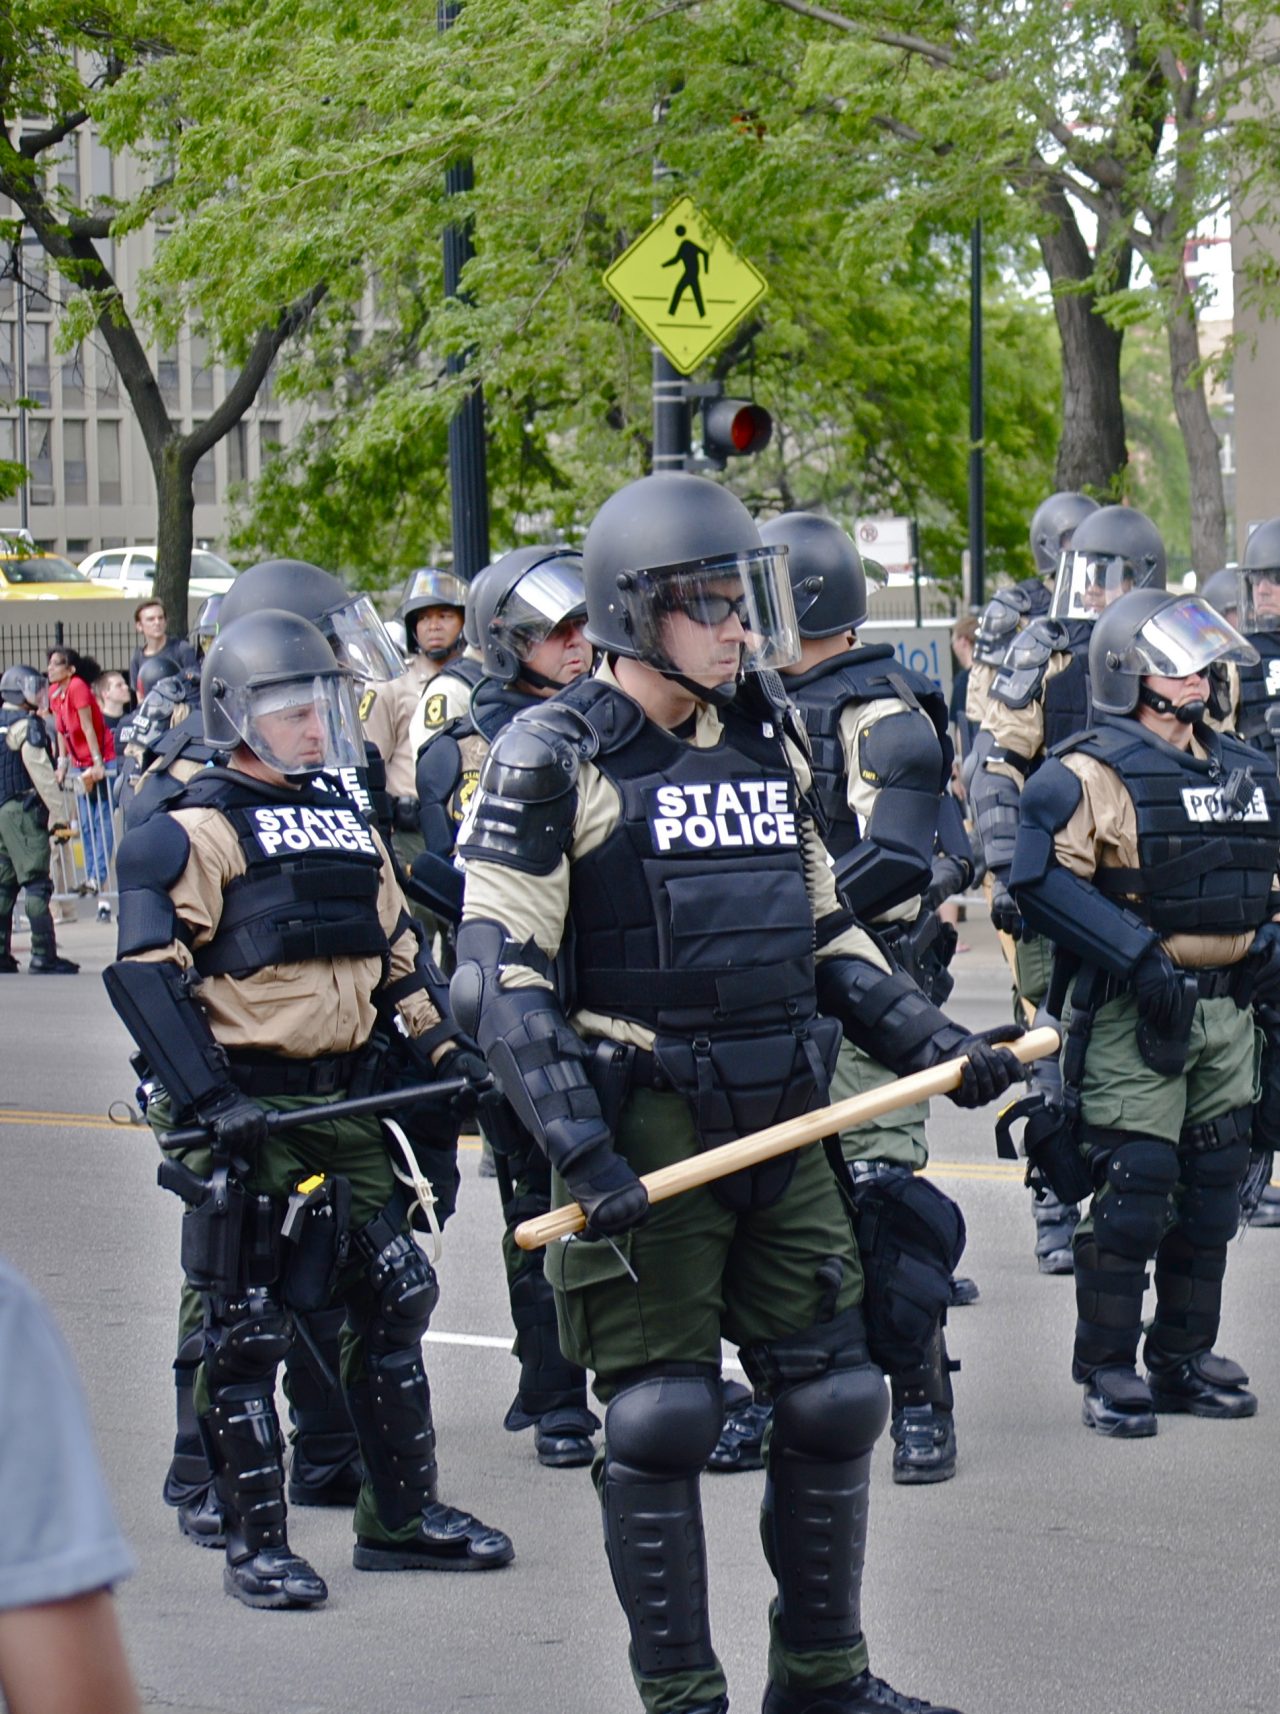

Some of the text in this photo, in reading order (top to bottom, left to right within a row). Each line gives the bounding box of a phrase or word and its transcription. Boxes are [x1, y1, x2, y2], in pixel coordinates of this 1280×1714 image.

[657, 781, 788, 817] STATE
[255, 807, 361, 832] STATE
[654, 812, 798, 851] POLICE
[258, 828, 377, 855] POLICE
